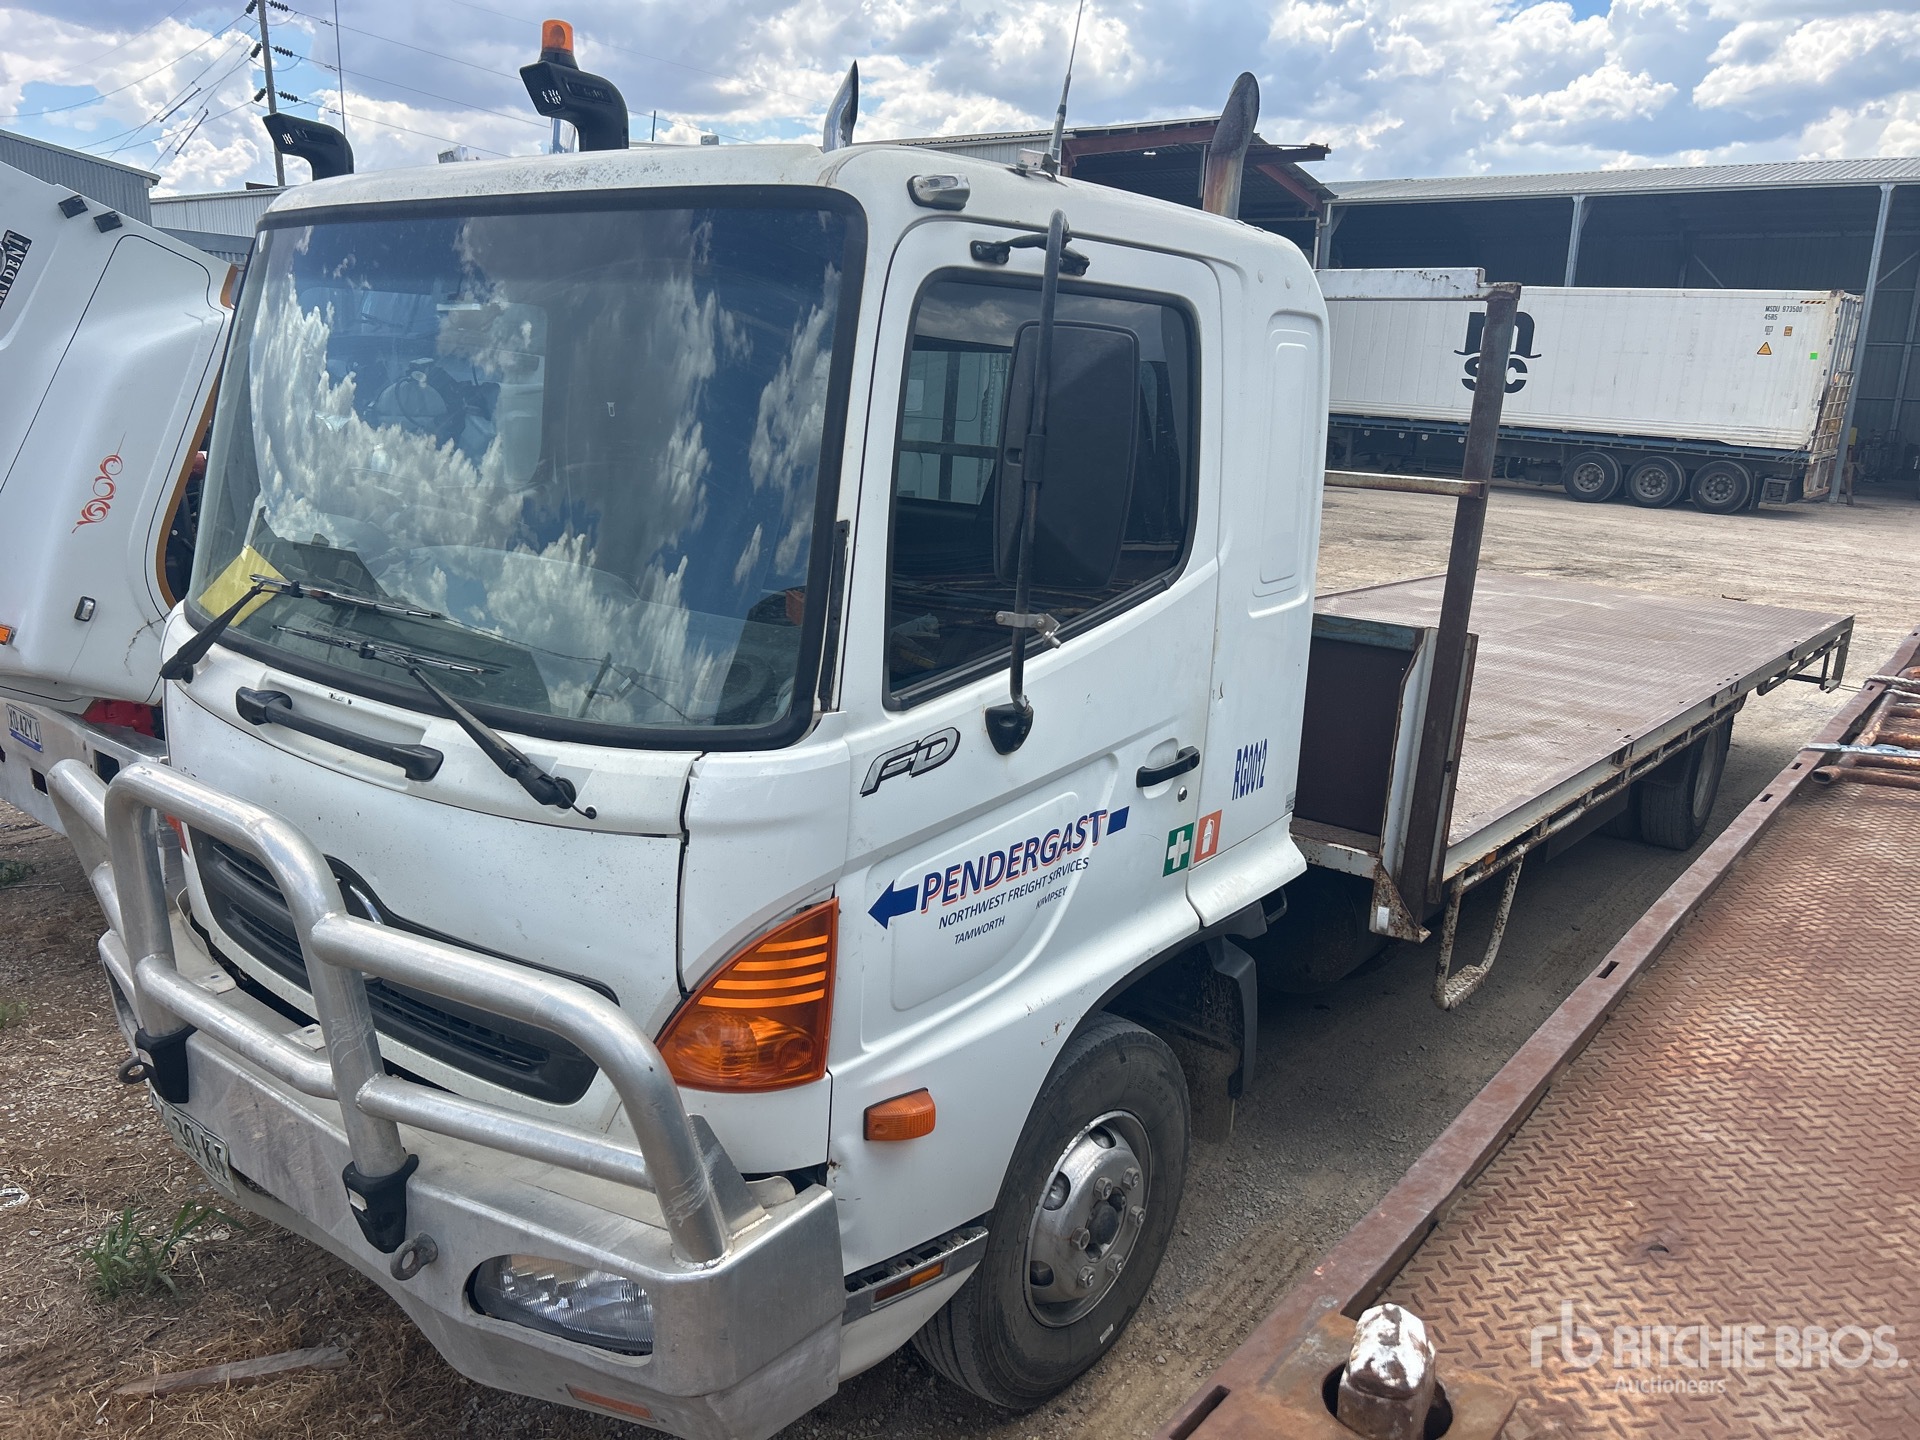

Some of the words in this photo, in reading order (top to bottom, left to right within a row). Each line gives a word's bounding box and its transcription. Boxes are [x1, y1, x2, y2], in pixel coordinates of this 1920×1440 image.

[0, 231, 30, 304] IDENT
[860, 727, 960, 797] FD
[1231, 738, 1268, 801] RG0012
[920, 809, 1108, 914] PENDERGAST
[938, 892, 1007, 930] NORTHWEST
[1007, 874, 1048, 903] FREIGHT
[1047, 856, 1090, 886] SERVICES
[954, 915, 1006, 945] TAMWORTH
